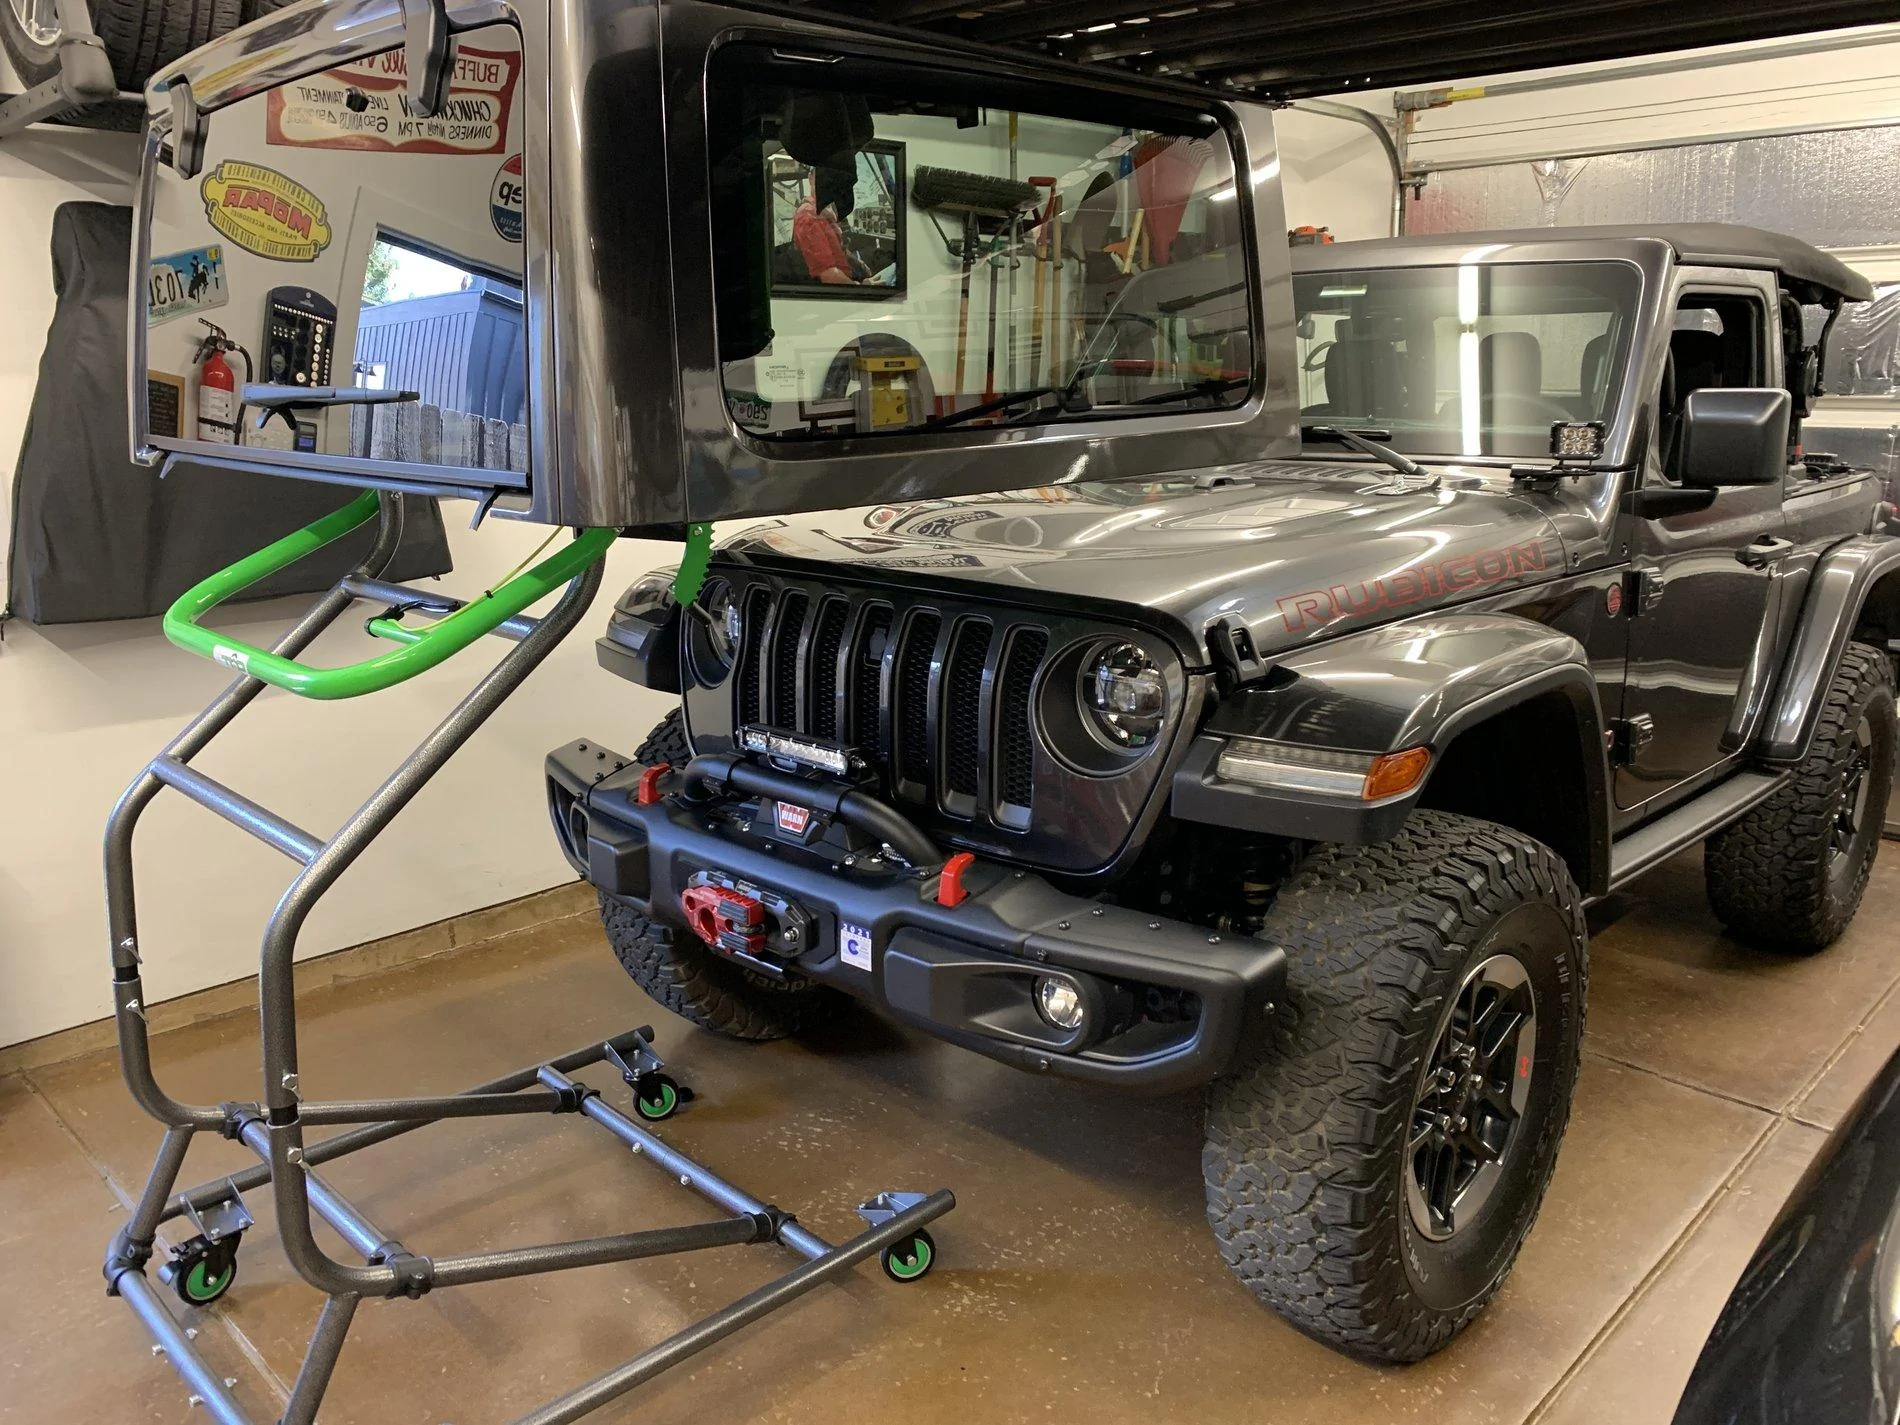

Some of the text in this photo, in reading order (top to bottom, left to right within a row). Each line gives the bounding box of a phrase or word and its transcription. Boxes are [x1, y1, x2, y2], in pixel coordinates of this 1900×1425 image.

[1275, 539, 1546, 632] RUBICON
[781, 810, 804, 825] WARN
[843, 923, 870, 939] 2021
